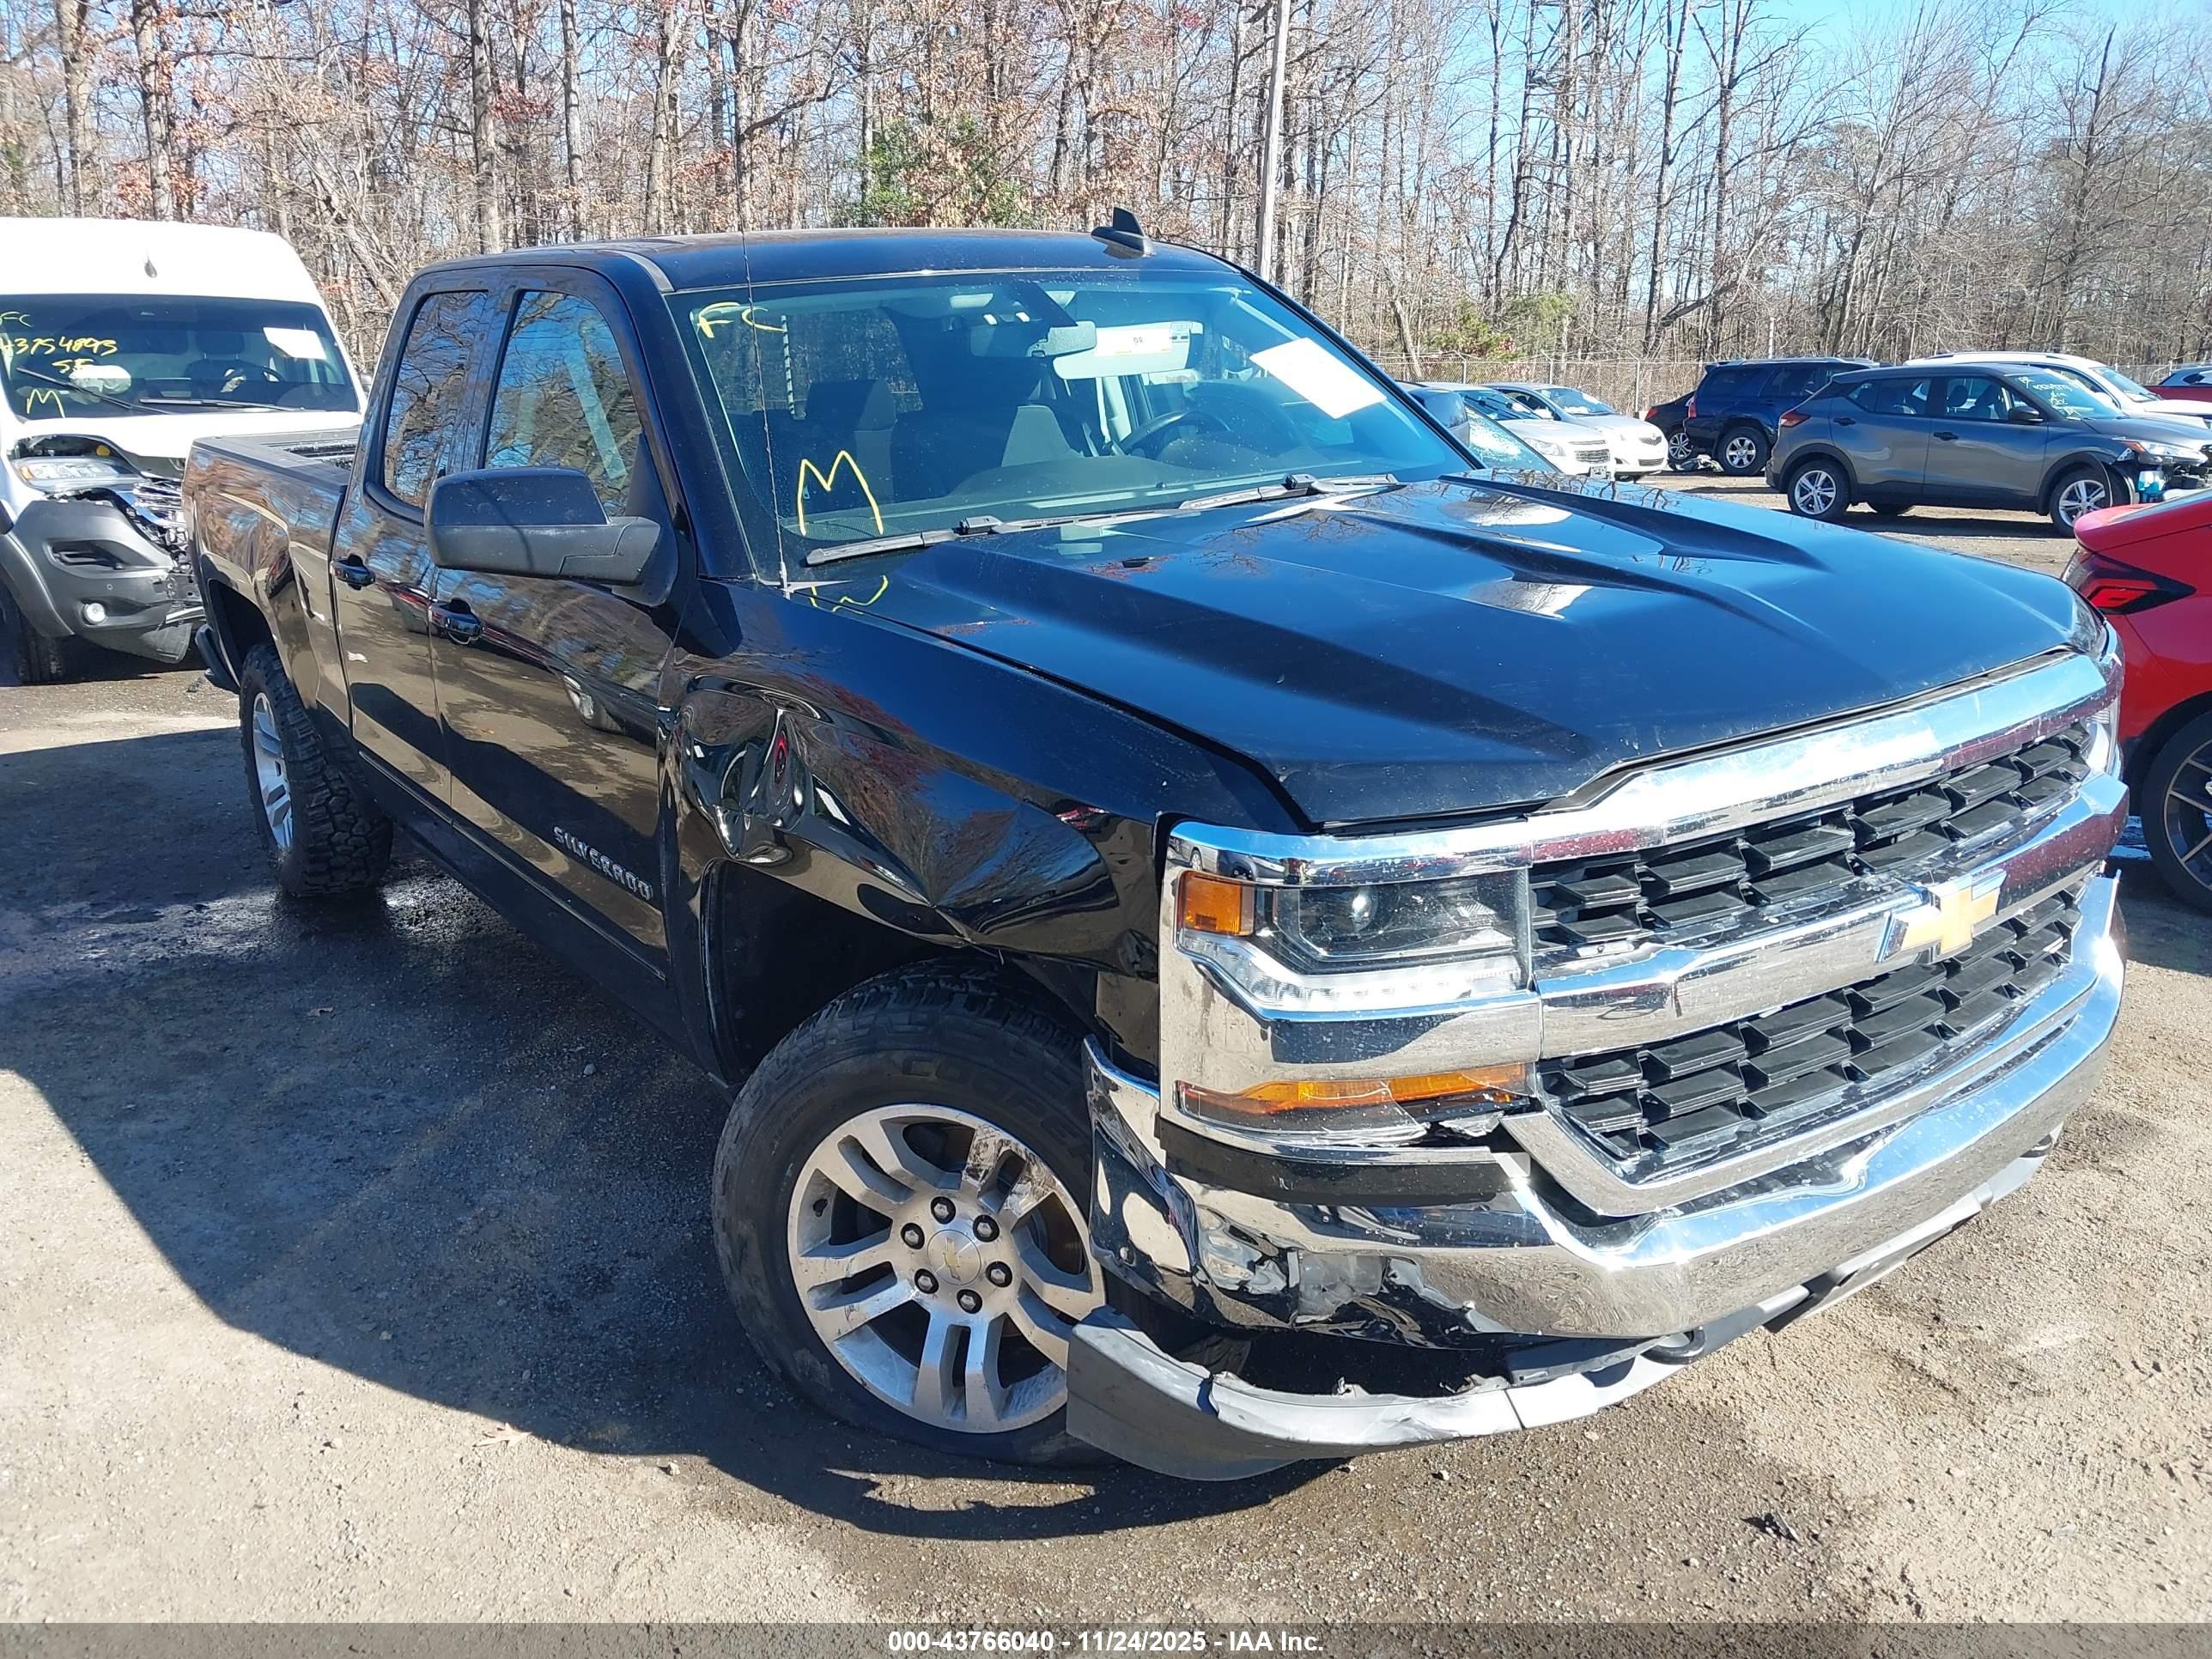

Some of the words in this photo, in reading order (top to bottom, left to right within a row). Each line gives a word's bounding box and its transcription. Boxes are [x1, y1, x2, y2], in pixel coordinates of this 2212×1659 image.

[27, 388, 65, 419] M
[797, 450, 884, 536] M
[552, 825, 654, 902] SILVERADO
